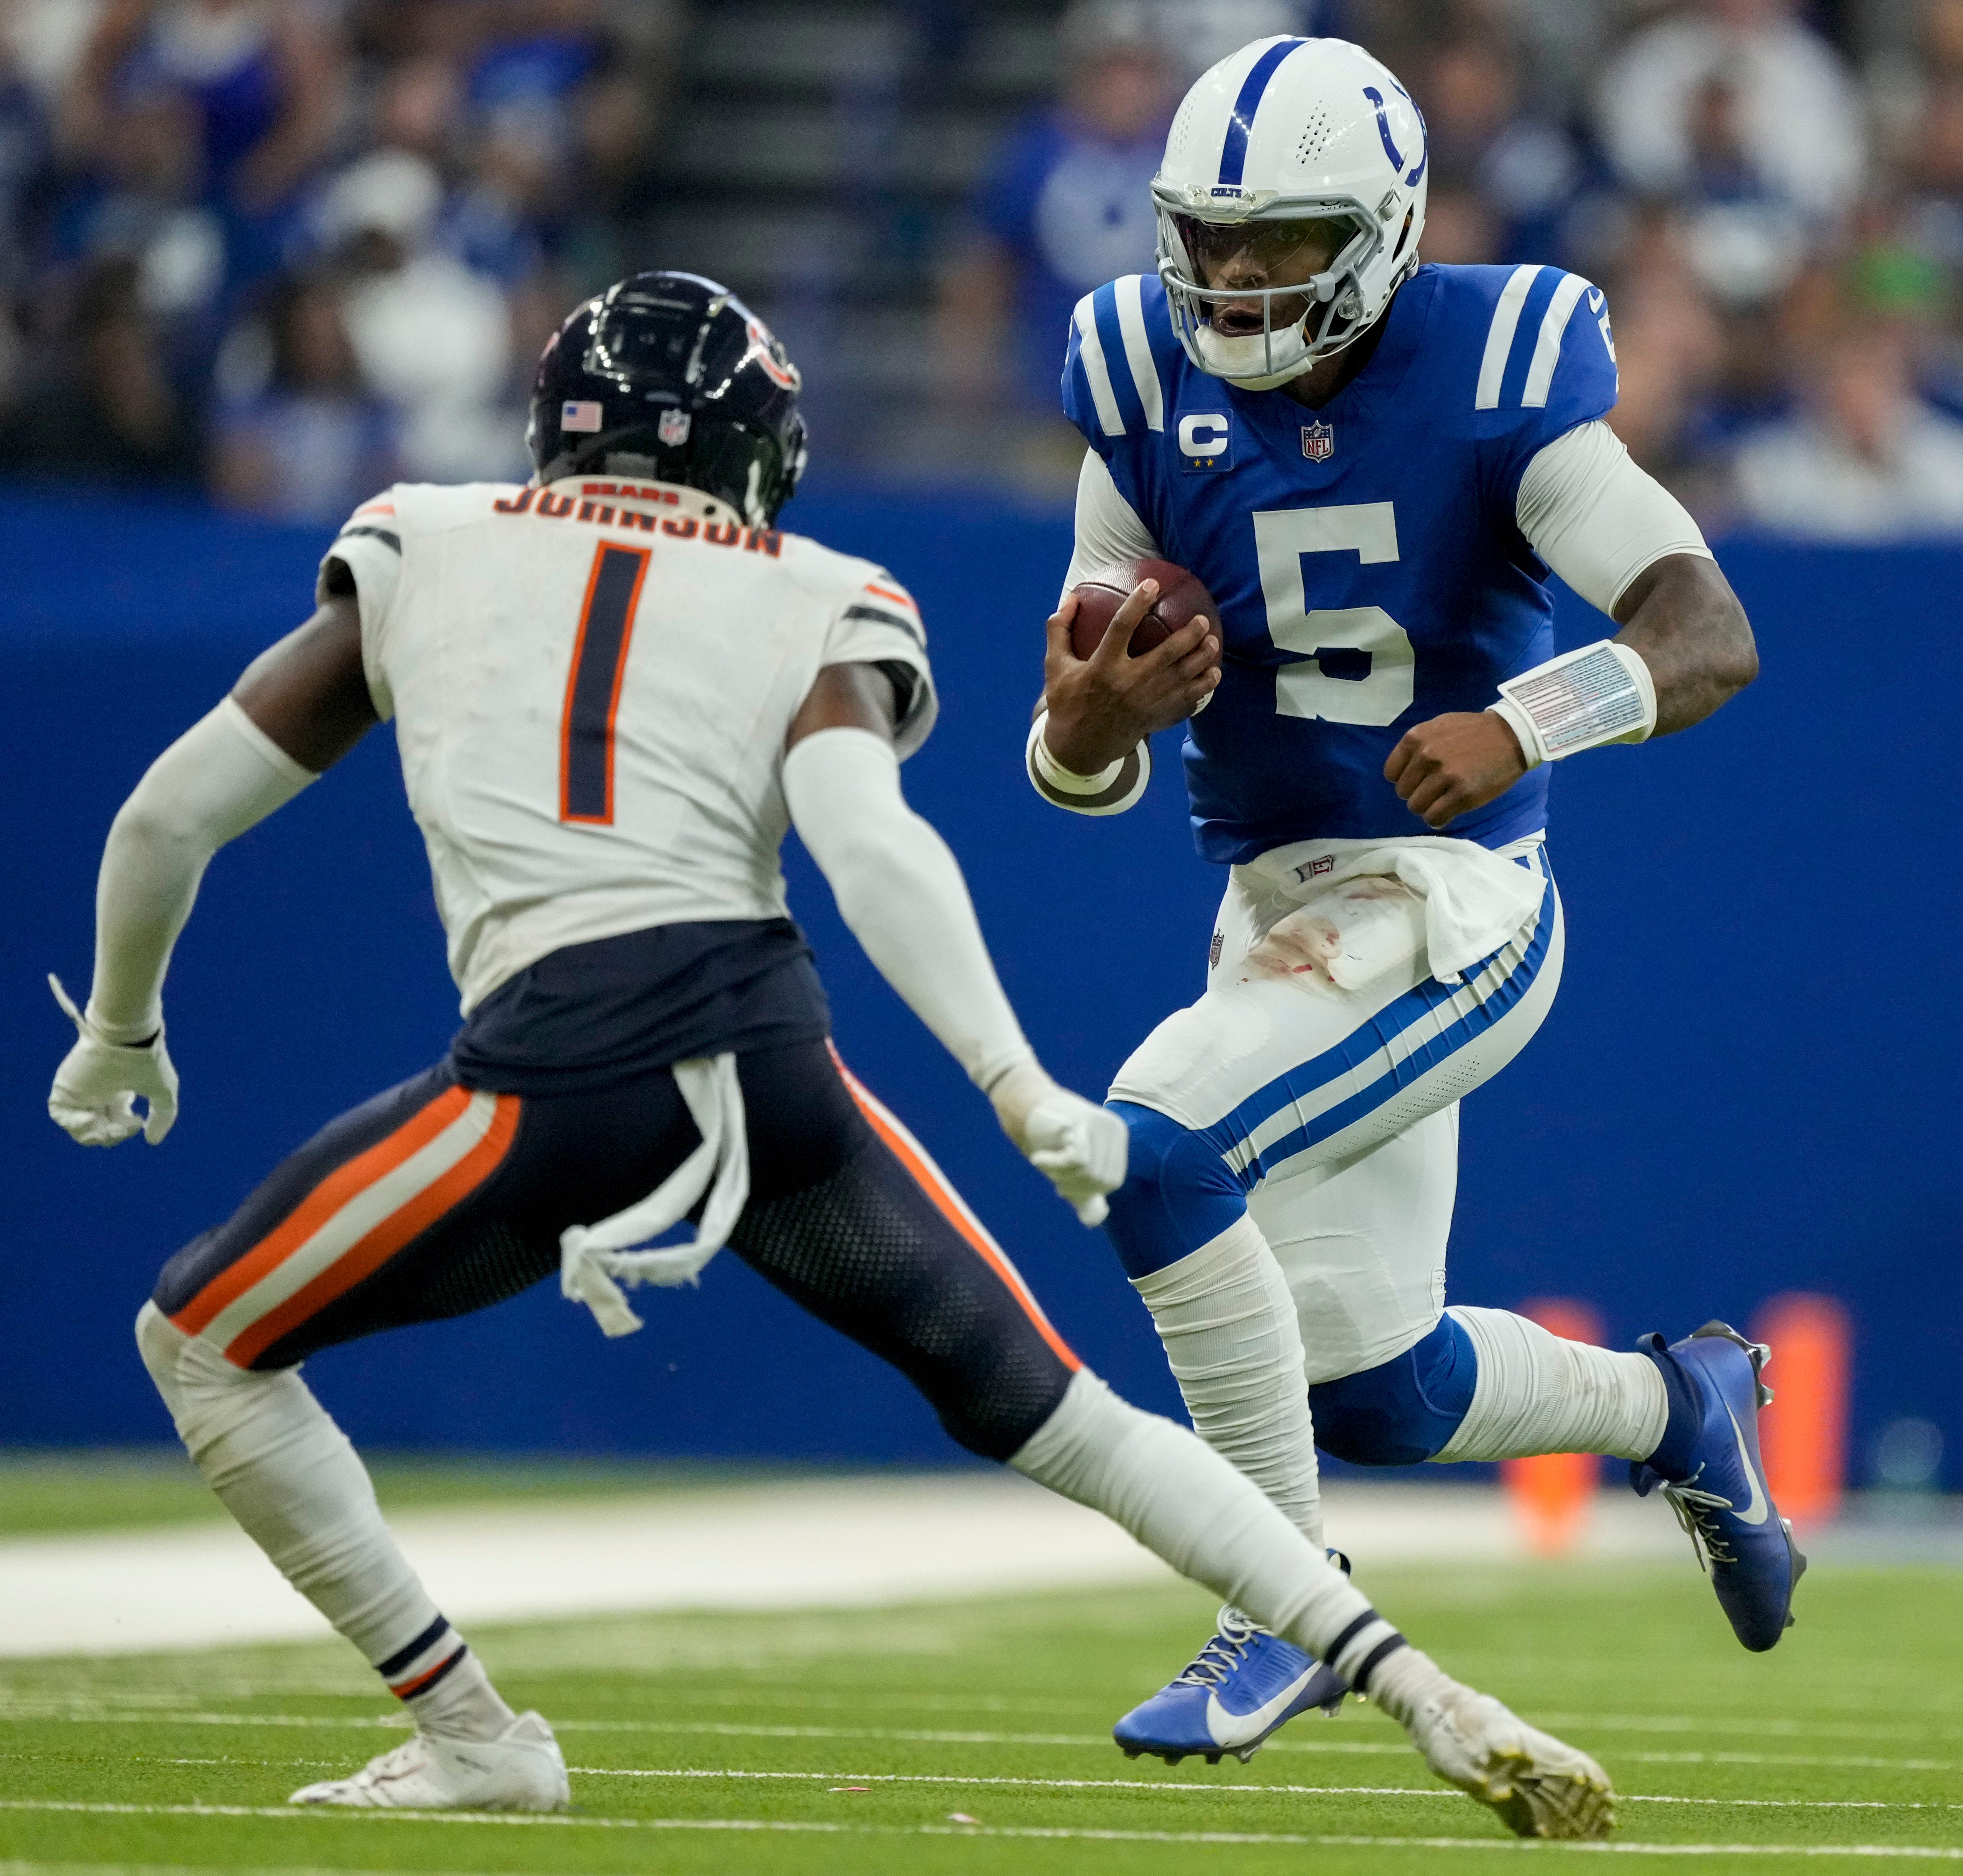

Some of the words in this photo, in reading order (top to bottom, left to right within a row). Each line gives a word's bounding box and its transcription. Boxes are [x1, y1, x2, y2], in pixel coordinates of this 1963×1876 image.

[1211, 188, 1242, 198] COLTS
[1179, 414, 1228, 457] C
[1307, 439, 1329, 455] NFL
[1252, 501, 1414, 727] 5
[559, 539, 653, 827] 1
